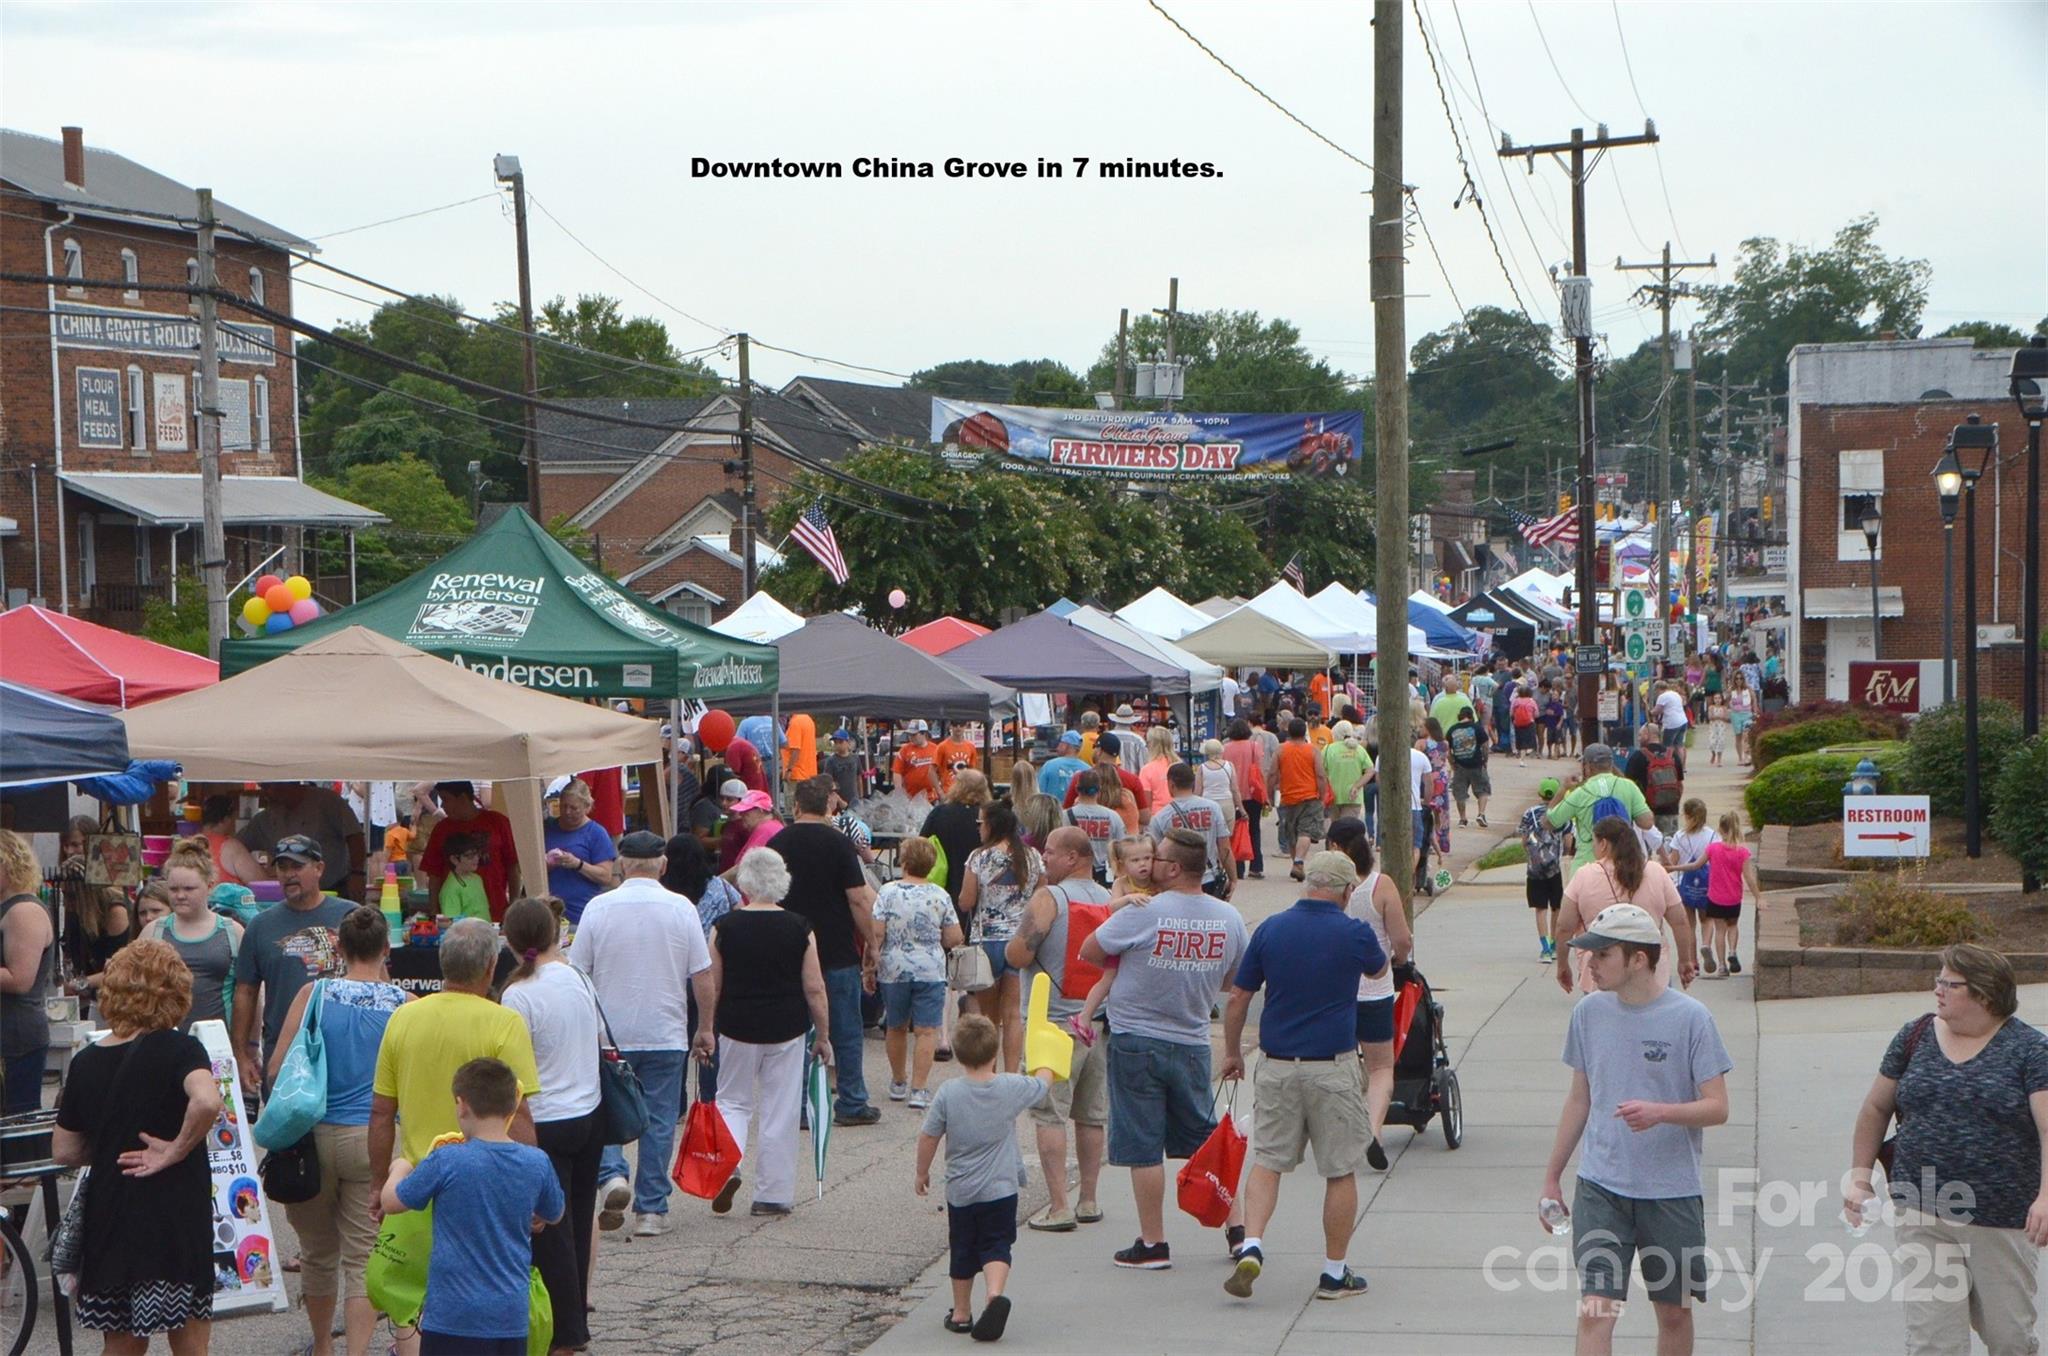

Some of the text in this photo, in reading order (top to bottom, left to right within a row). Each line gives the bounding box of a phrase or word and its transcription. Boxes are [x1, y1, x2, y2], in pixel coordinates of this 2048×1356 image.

[60, 315, 102, 339] CHINA
[106, 321, 151, 344] GROVE
[82, 377, 114, 394] FLOUR
[84, 399, 112, 416] MEAL
[1145, 416, 1167, 425] JULY
[1171, 417, 1193, 425] 9AM
[1204, 417, 1230, 425] 10PM
[83, 421, 117, 438] FEEDS
[159, 425, 184, 442] FEEDS
[1051, 438, 1240, 470] FARMERS DAY
[430, 573, 545, 594] Renewal
[1847, 809, 1926, 822] RESTROOM
[1078, 820, 1111, 838] IRE
[1158, 917, 1227, 931] LONG CREEK
[1151, 928, 1227, 960] FIRE
[1147, 957, 1222, 972] DEPARTMENT
[229, 1163, 247, 1175] $10
